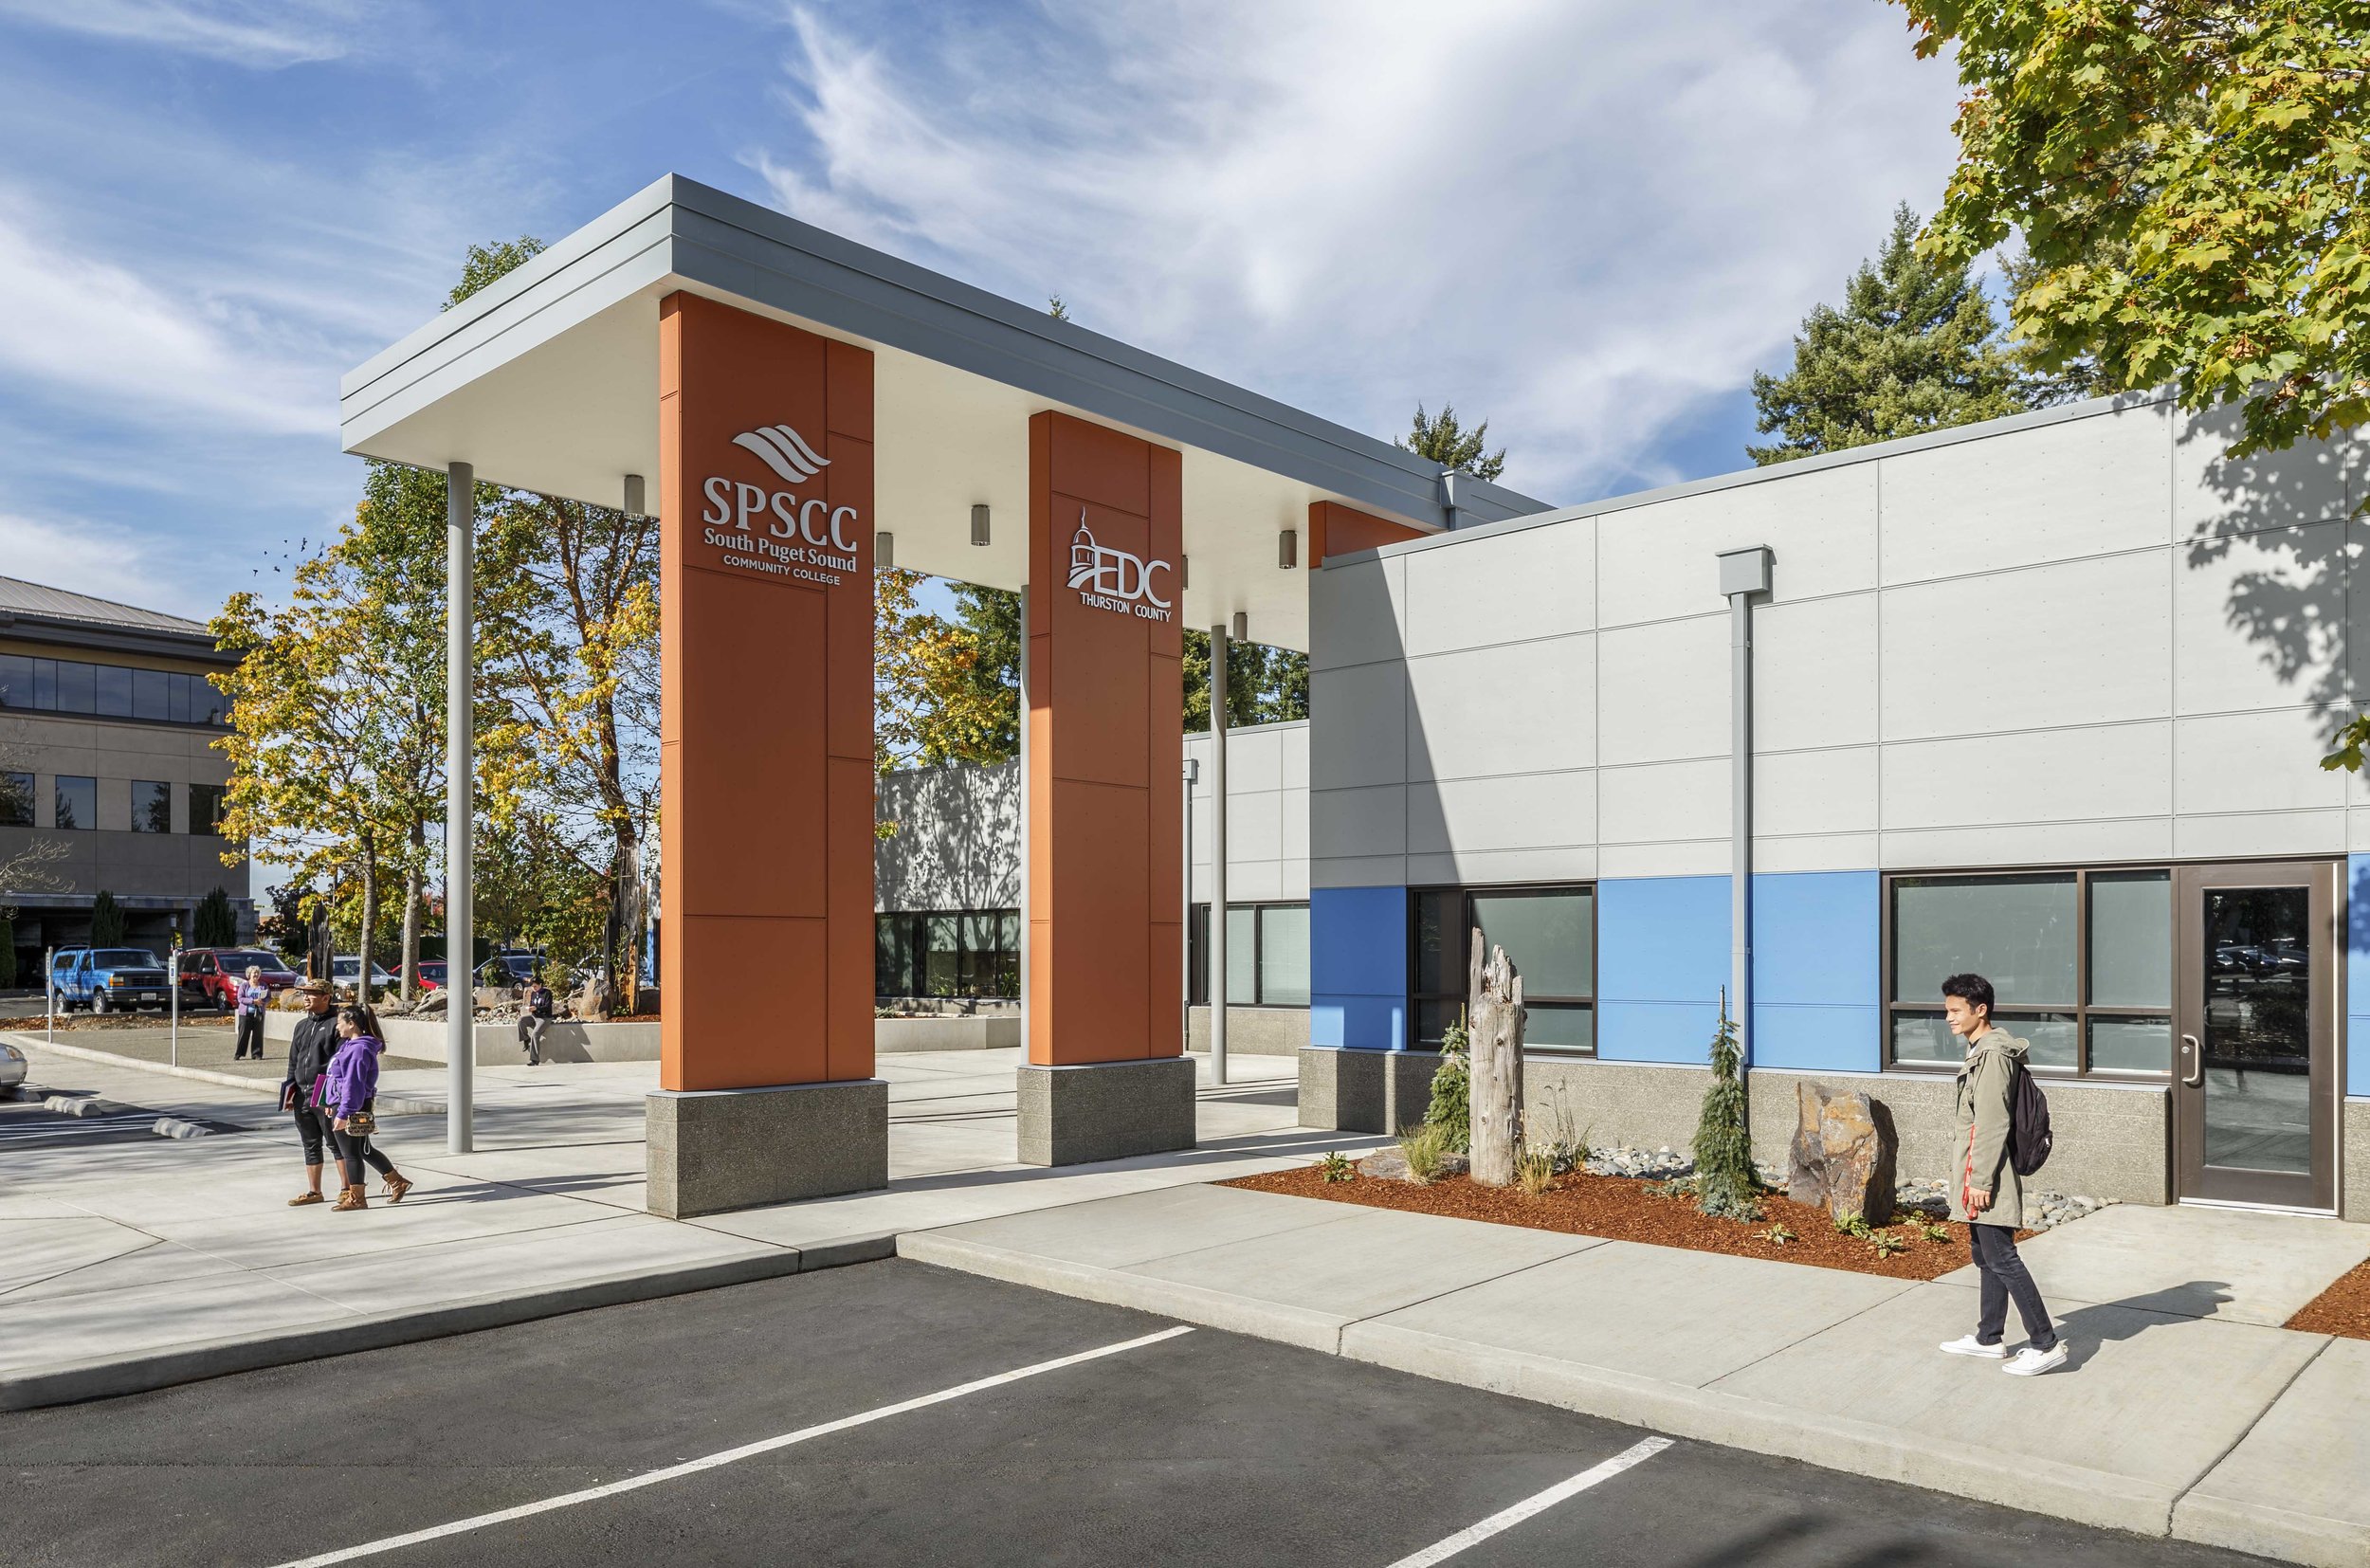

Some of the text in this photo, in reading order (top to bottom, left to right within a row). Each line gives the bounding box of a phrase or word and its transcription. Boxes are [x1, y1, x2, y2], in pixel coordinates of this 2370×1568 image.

[702, 477, 857, 553] SPSCC
[704, 527, 857, 573] South Puget Sound
[723, 555, 841, 586] COMMUNITY COLLEGE
[1093, 545, 1172, 608] EDC
[1080, 592, 1172, 623] THURSTON COUNTY
